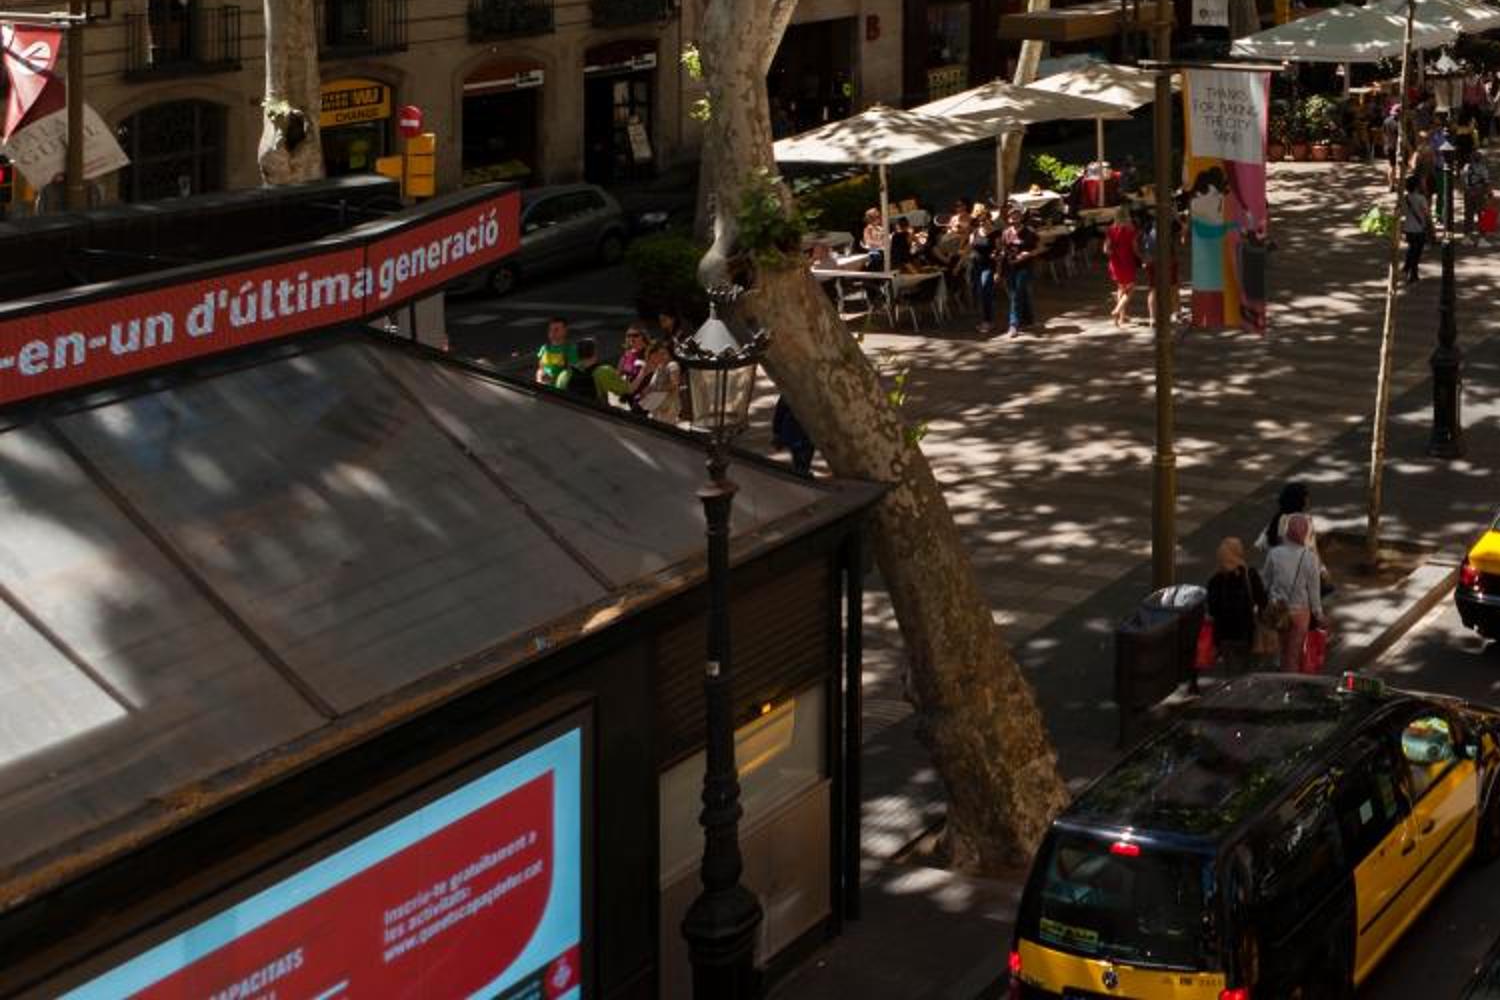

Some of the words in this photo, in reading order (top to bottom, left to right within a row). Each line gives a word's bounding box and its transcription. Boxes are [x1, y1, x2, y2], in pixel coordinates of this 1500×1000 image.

[186, 266, 375, 338] d'última
[379, 207, 500, 299] generació
[209, 947, 304, 1000] APACITATS
